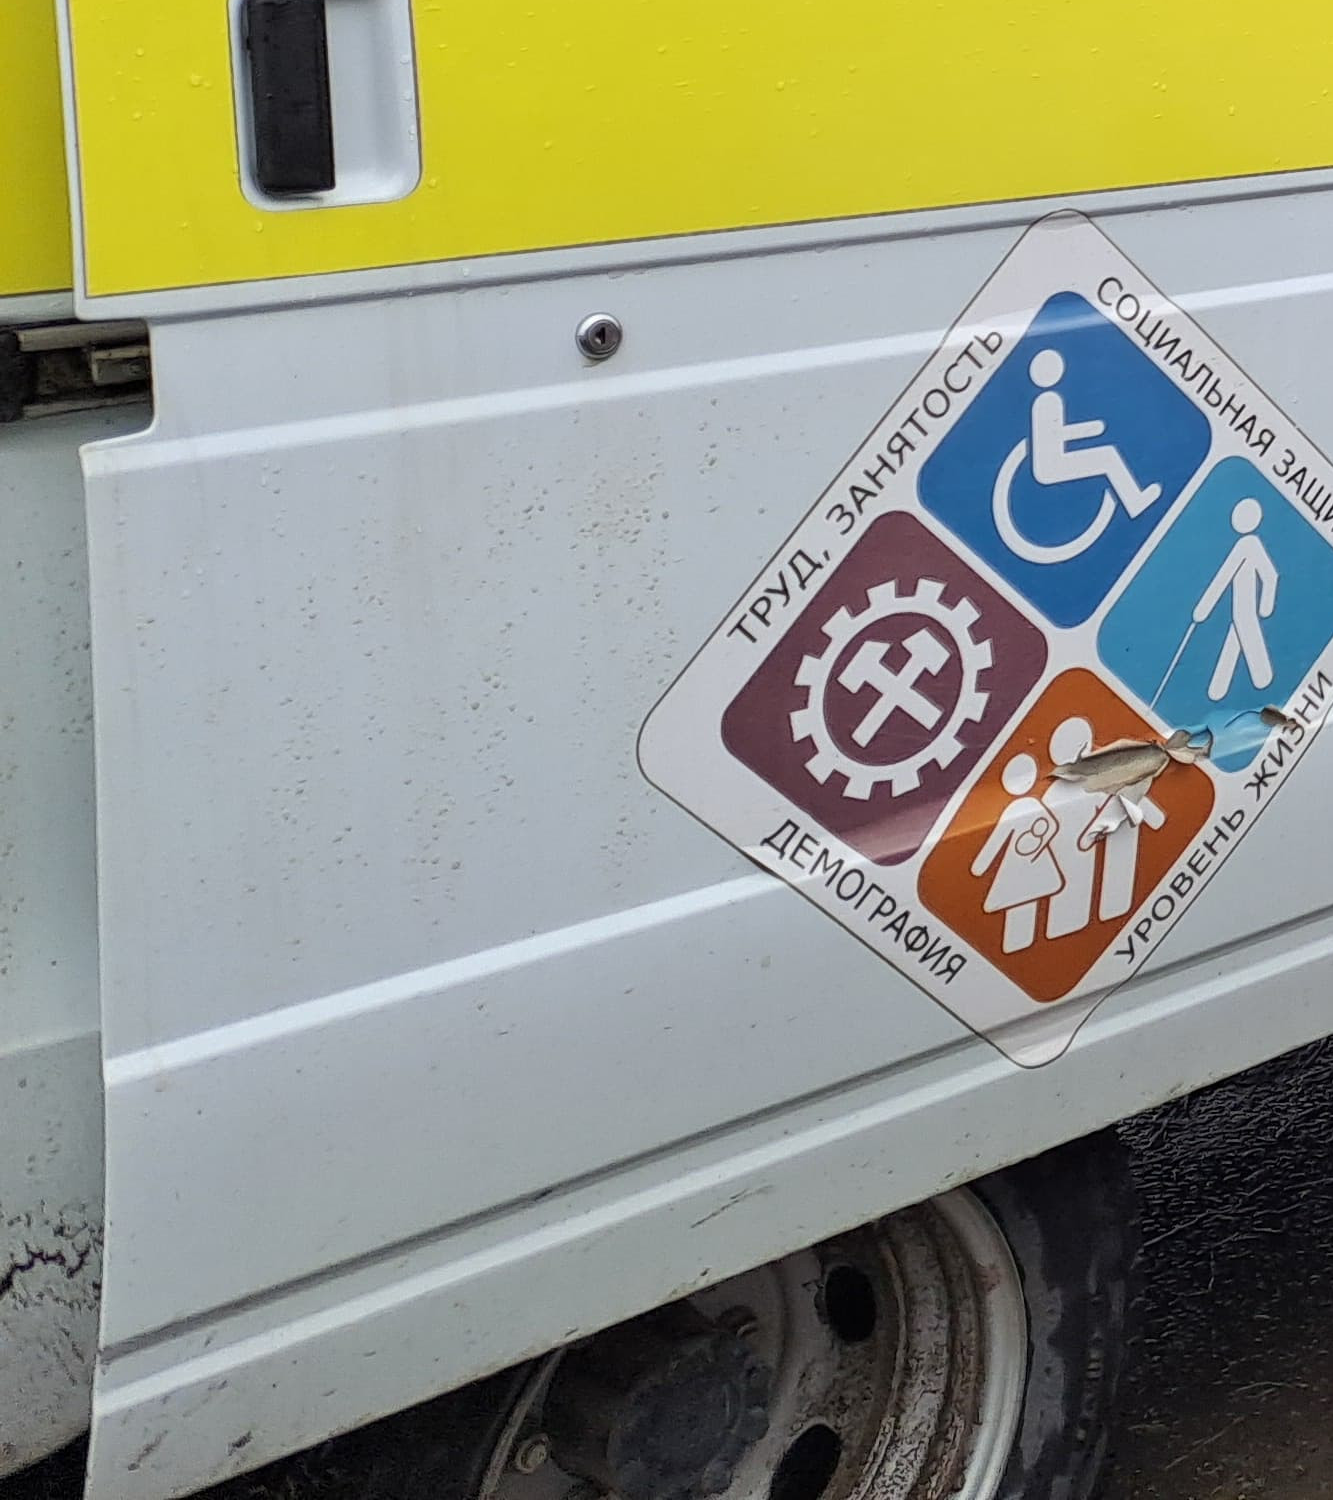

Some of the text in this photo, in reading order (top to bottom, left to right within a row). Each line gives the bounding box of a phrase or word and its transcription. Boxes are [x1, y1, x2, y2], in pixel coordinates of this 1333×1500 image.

[1096, 276, 1276, 457] СОЦИАЛЬНАЯ
[727, 330, 1004, 644] ТРУД, ЗАНЯТОСТЬ
[760, 818, 968, 986] ДЕМОГРАФИЯ
[1114, 670, 1333, 965] УРОВЕНЬ ЖИЗНИ
